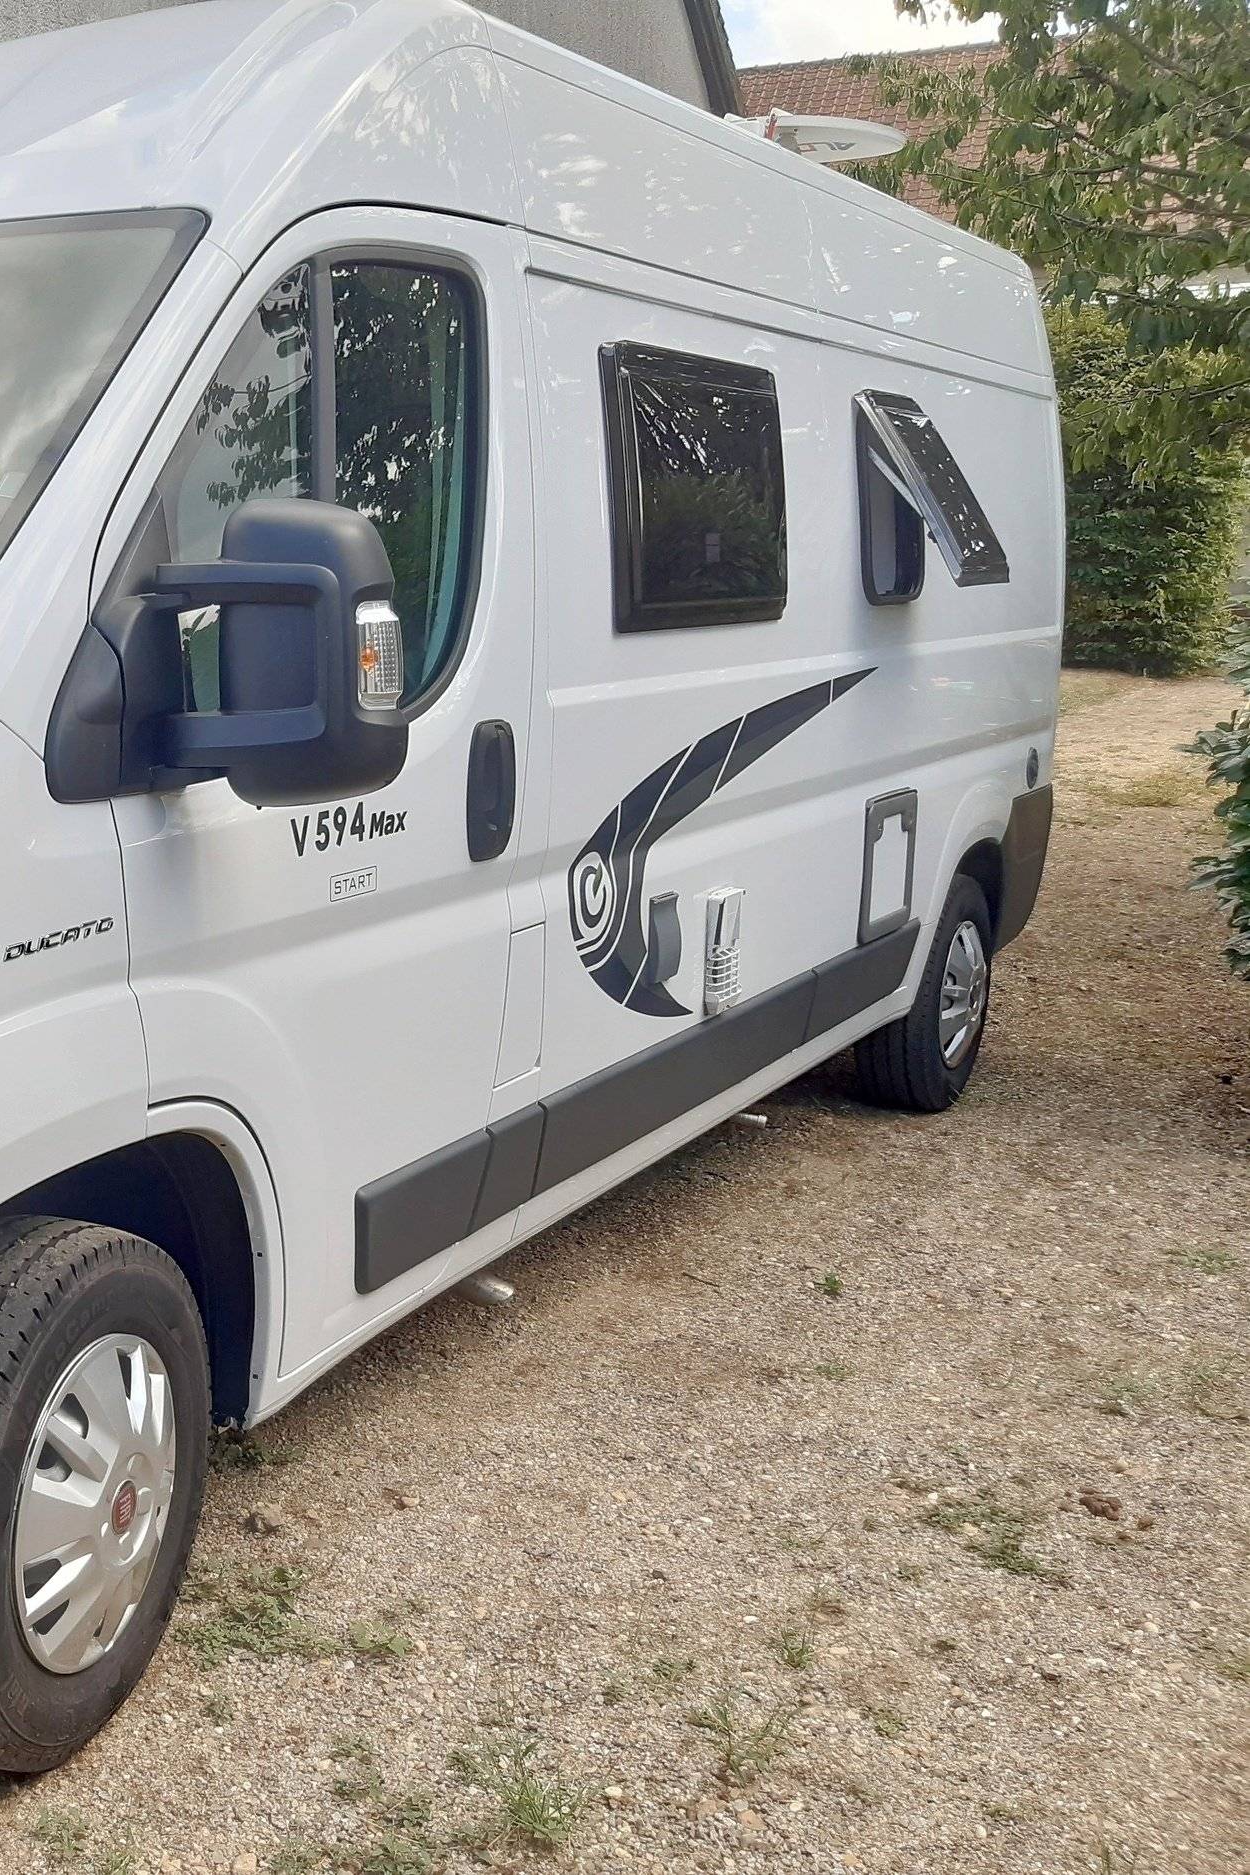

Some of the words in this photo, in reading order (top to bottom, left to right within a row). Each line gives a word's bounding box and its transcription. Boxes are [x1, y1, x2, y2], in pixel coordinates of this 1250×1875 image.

[369, 810, 408, 840] Max
[334, 872, 373, 895] START
[2, 916, 114, 962] DUCATO
[119, 1492, 131, 1524] FIAT
